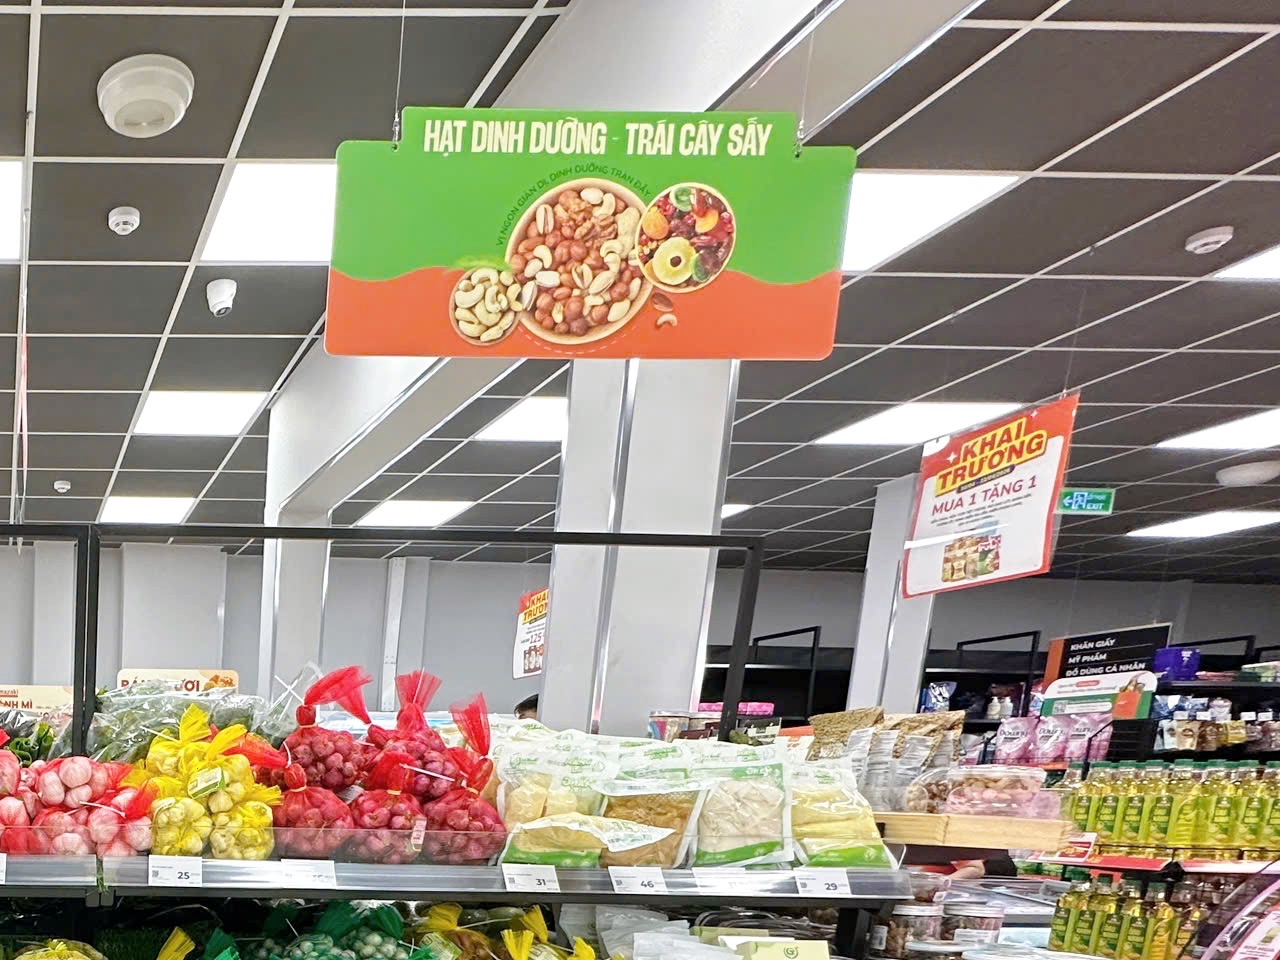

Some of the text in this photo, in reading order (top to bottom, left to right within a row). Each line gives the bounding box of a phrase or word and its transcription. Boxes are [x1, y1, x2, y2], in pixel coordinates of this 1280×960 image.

[424, 119, 468, 158] HẠT
[472, 121, 525, 154] DINH
[529, 117, 606, 156] DƯỠNG
[625, 119, 673, 156] TRÁI
[679, 119, 722, 156] CÂY
[726, 115, 772, 157] SẤY
[962, 418, 1027, 460] KHAI
[938, 437, 1046, 490] TRƯƠNG
[932, 498, 964, 516] MUA
[969, 493, 977, 506] 1
[982, 479, 1024, 503] TẶNG
[1028, 475, 1037, 489] 1
[178, 871, 190, 880] 25
[535, 878, 547, 886] 31
[641, 880, 654, 889] 46
[824, 883, 838, 891] 29
